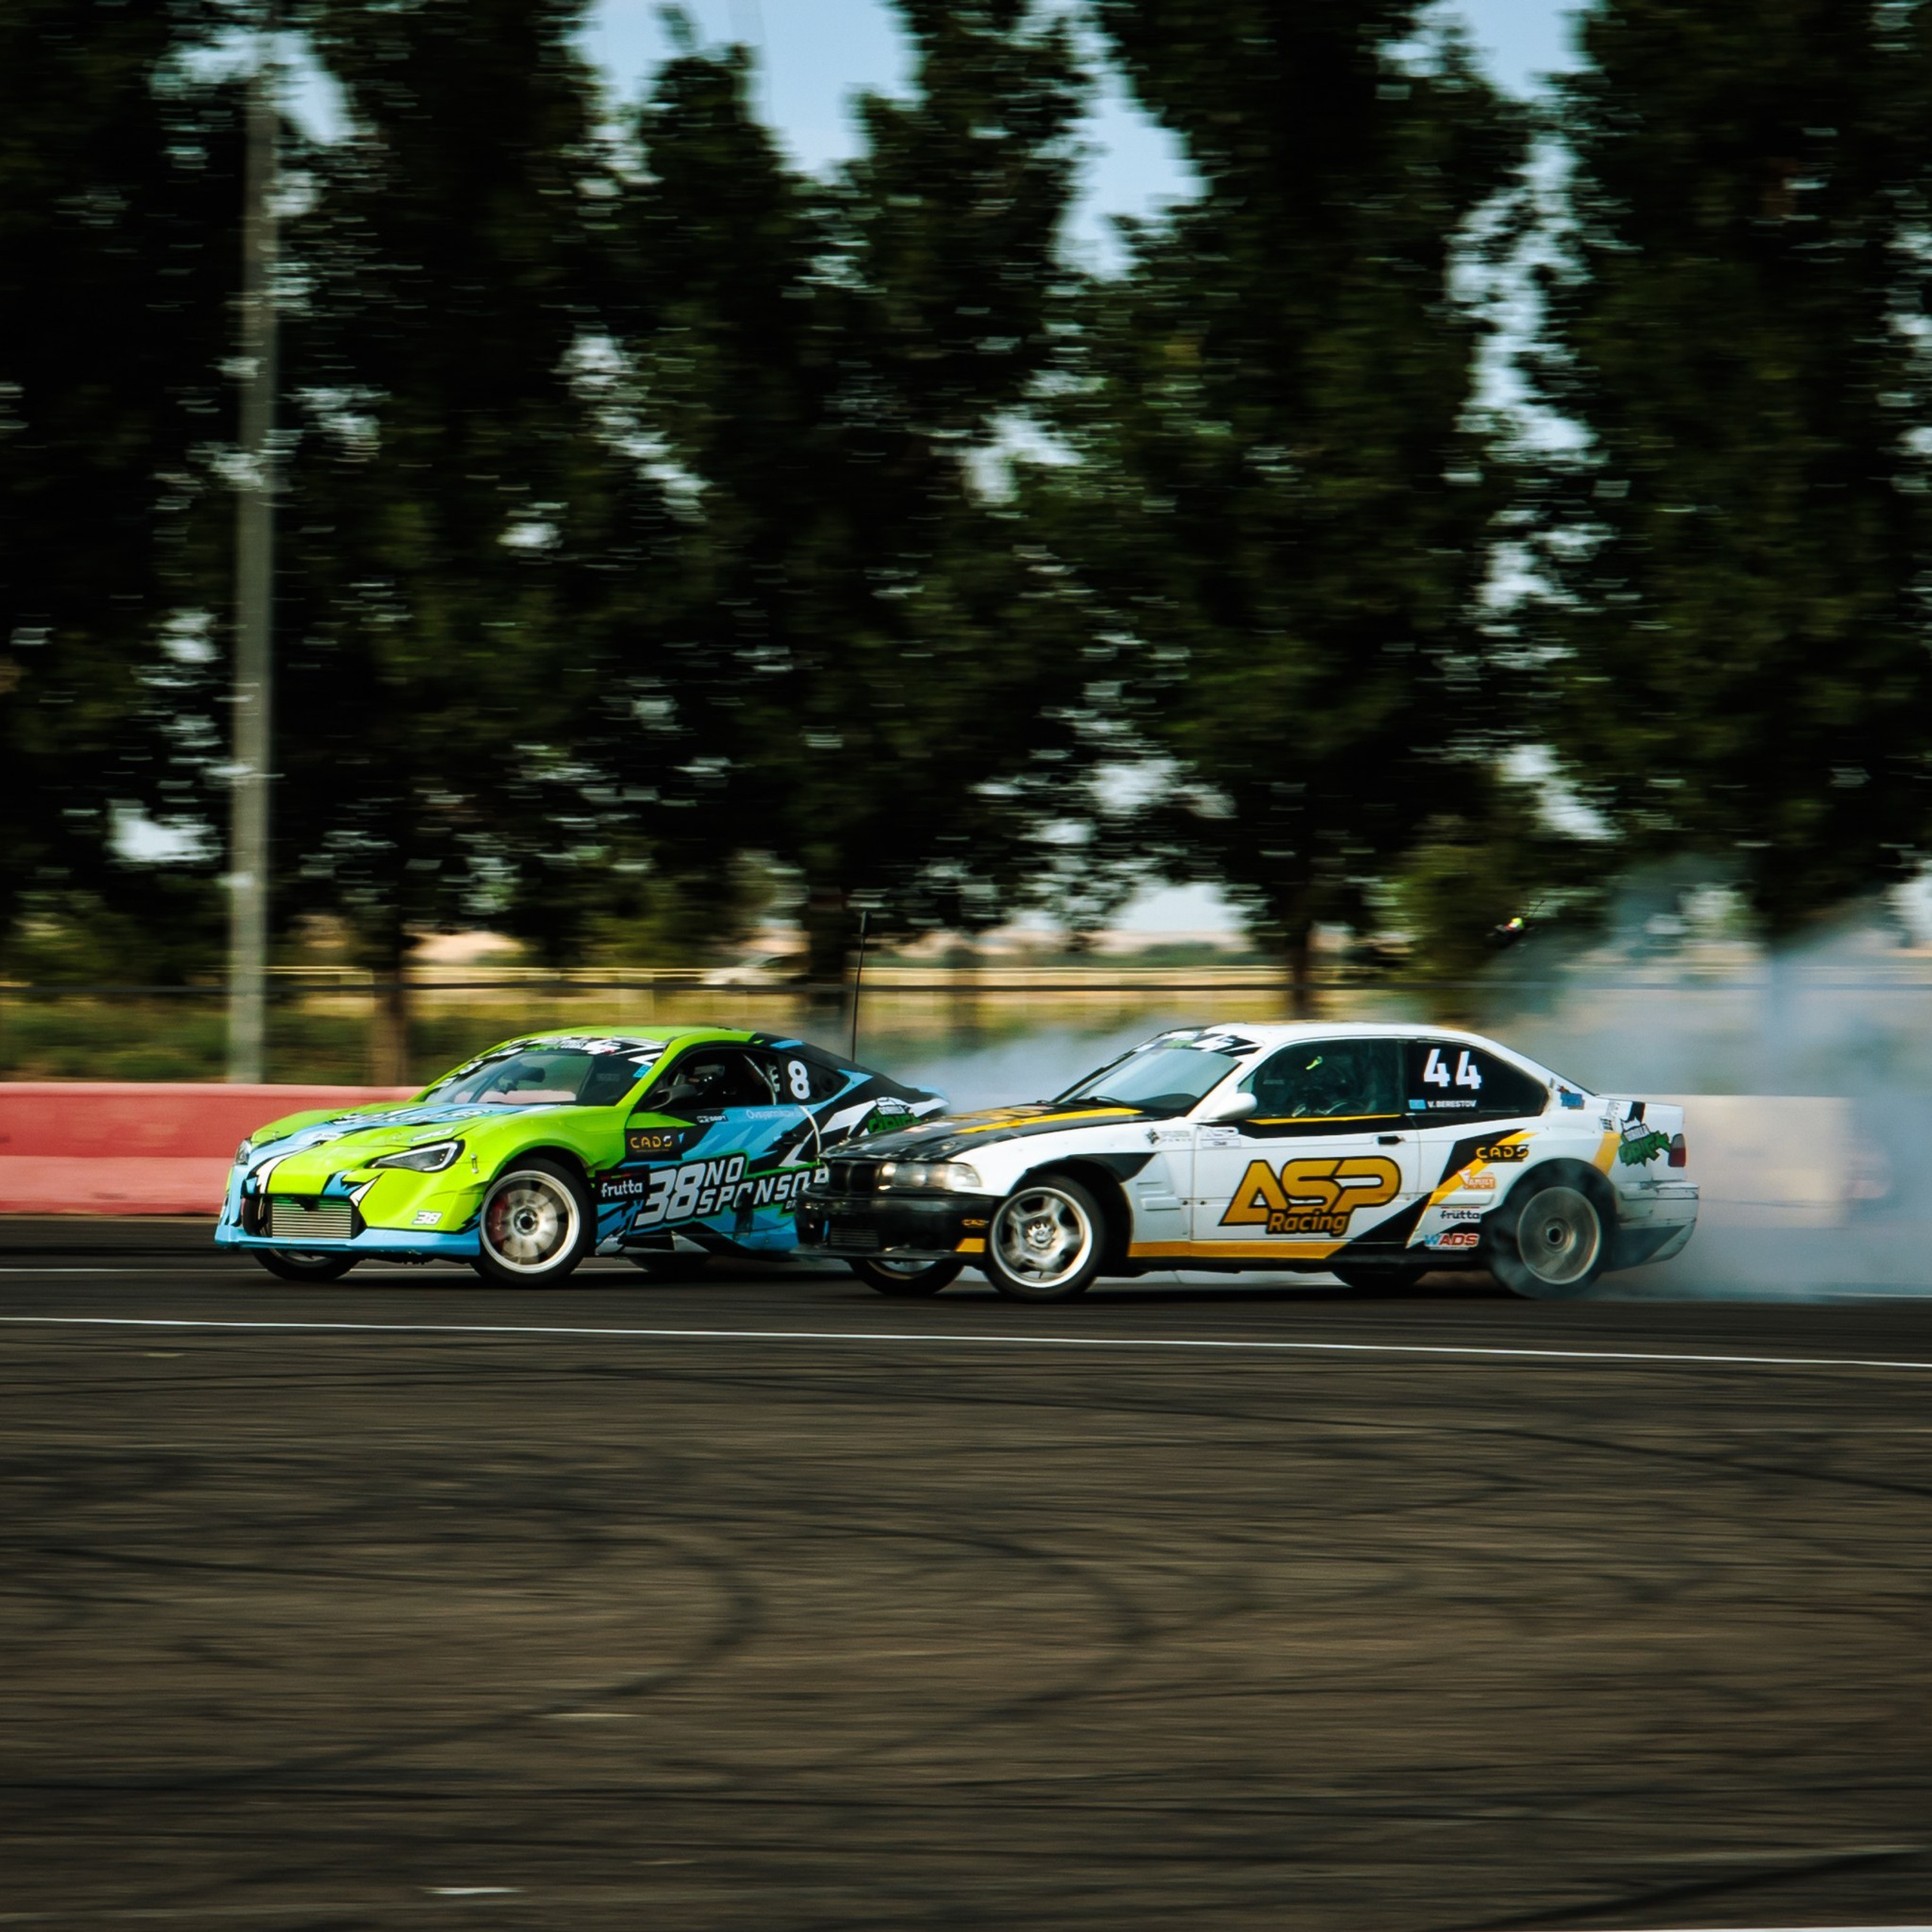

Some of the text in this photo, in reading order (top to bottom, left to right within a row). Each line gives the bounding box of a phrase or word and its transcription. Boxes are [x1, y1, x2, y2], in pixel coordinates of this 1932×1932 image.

[787, 1060, 811, 1100] 8
[1423, 1048, 1482, 1090] 44
[630, 1136, 672, 1149] CADS
[1476, 1146, 1530, 1158] CADS
[704, 1156, 744, 1187] NO
[601, 1180, 643, 1198] frutta
[635, 1164, 706, 1226] 38
[1218, 1155, 1402, 1226] ASP
[412, 1211, 443, 1225] 38
[1266, 1208, 1350, 1236] Racing
[1440, 1210, 1481, 1220] frutta
